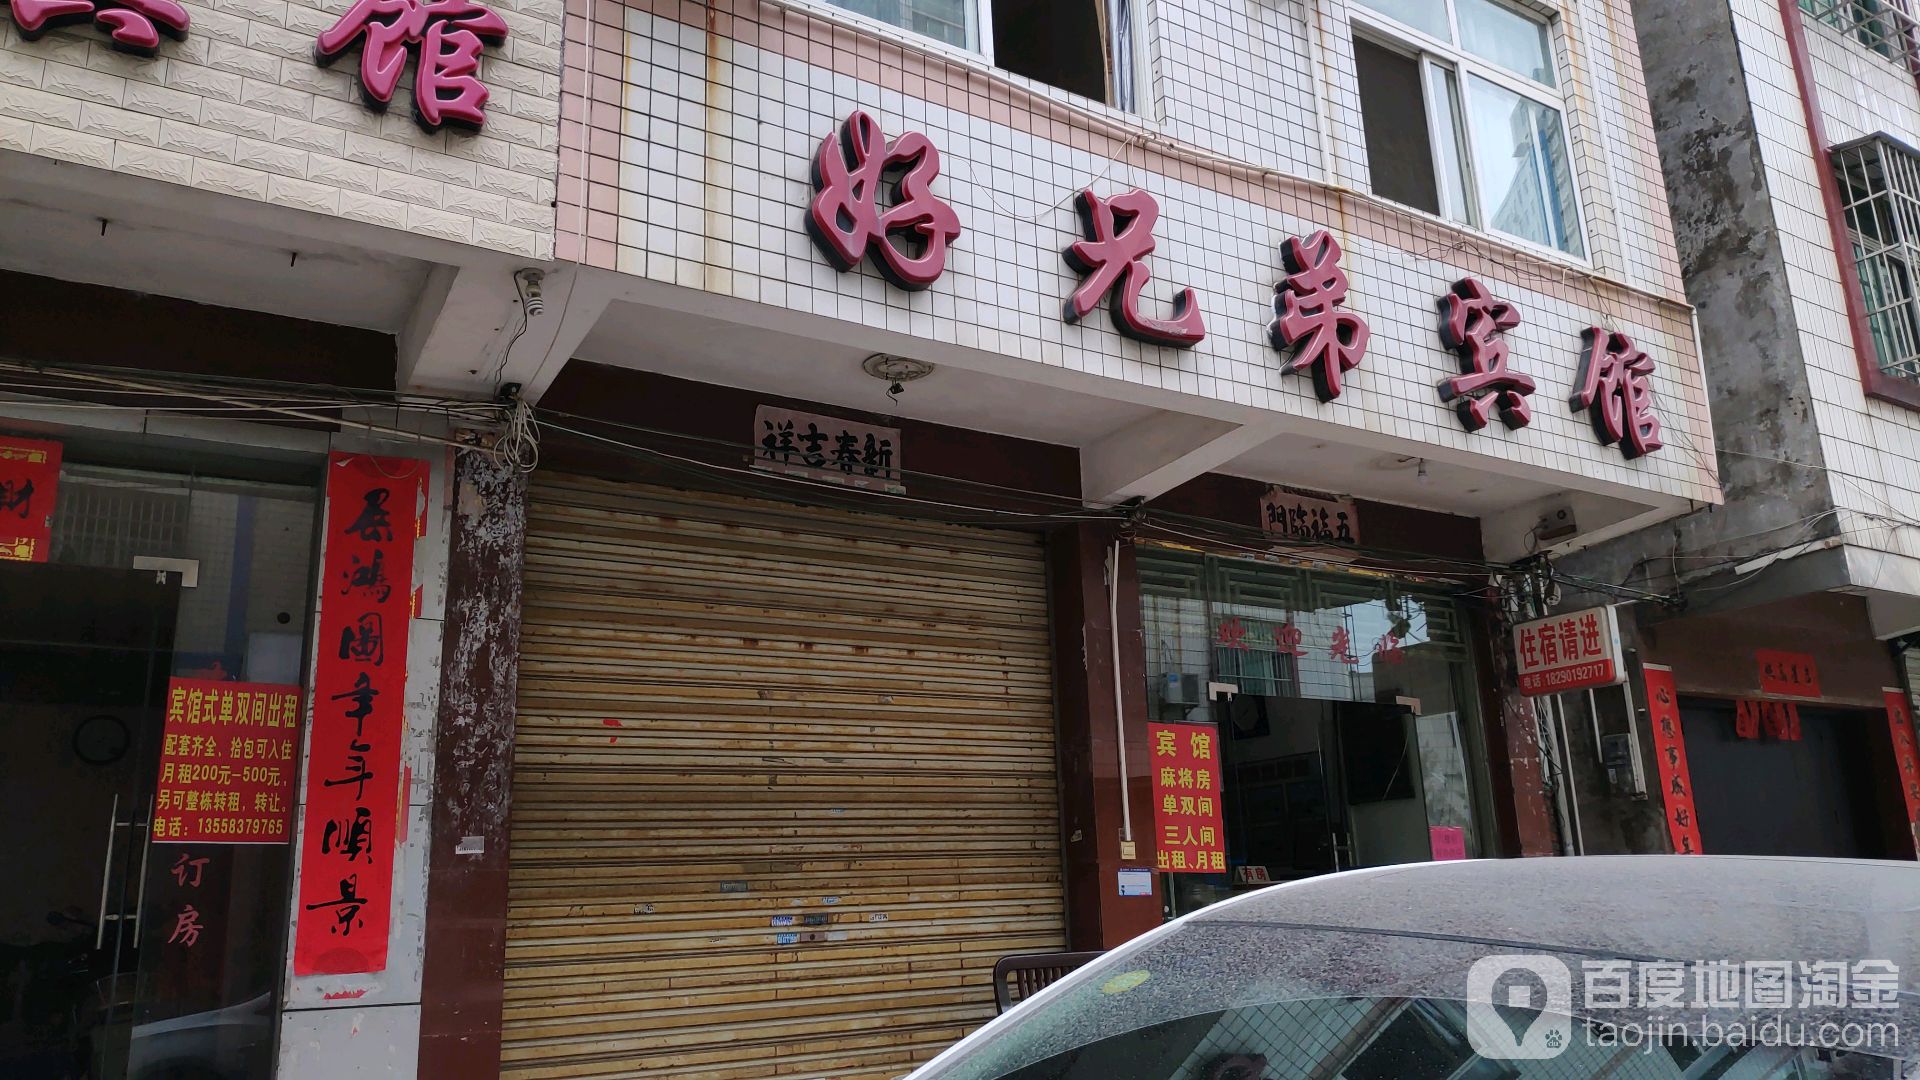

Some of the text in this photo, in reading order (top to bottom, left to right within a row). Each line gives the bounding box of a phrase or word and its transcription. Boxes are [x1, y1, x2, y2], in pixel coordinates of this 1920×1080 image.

[805, 110, 1662, 460] 好兄弟宾馆
[1520, 613, 1602, 669] 住宿请进
[1523, 664, 1605, 689] 电话 18290192717
[169, 686, 298, 728] 宾馆式单双间出租
[1156, 730, 1211, 760] 宾馆
[1160, 766, 1211, 790] 麻将房
[1162, 794, 1213, 817] 单双间
[1164, 825, 1216, 847] 三人间
[1157, 850, 1226, 870] 出租、月租
